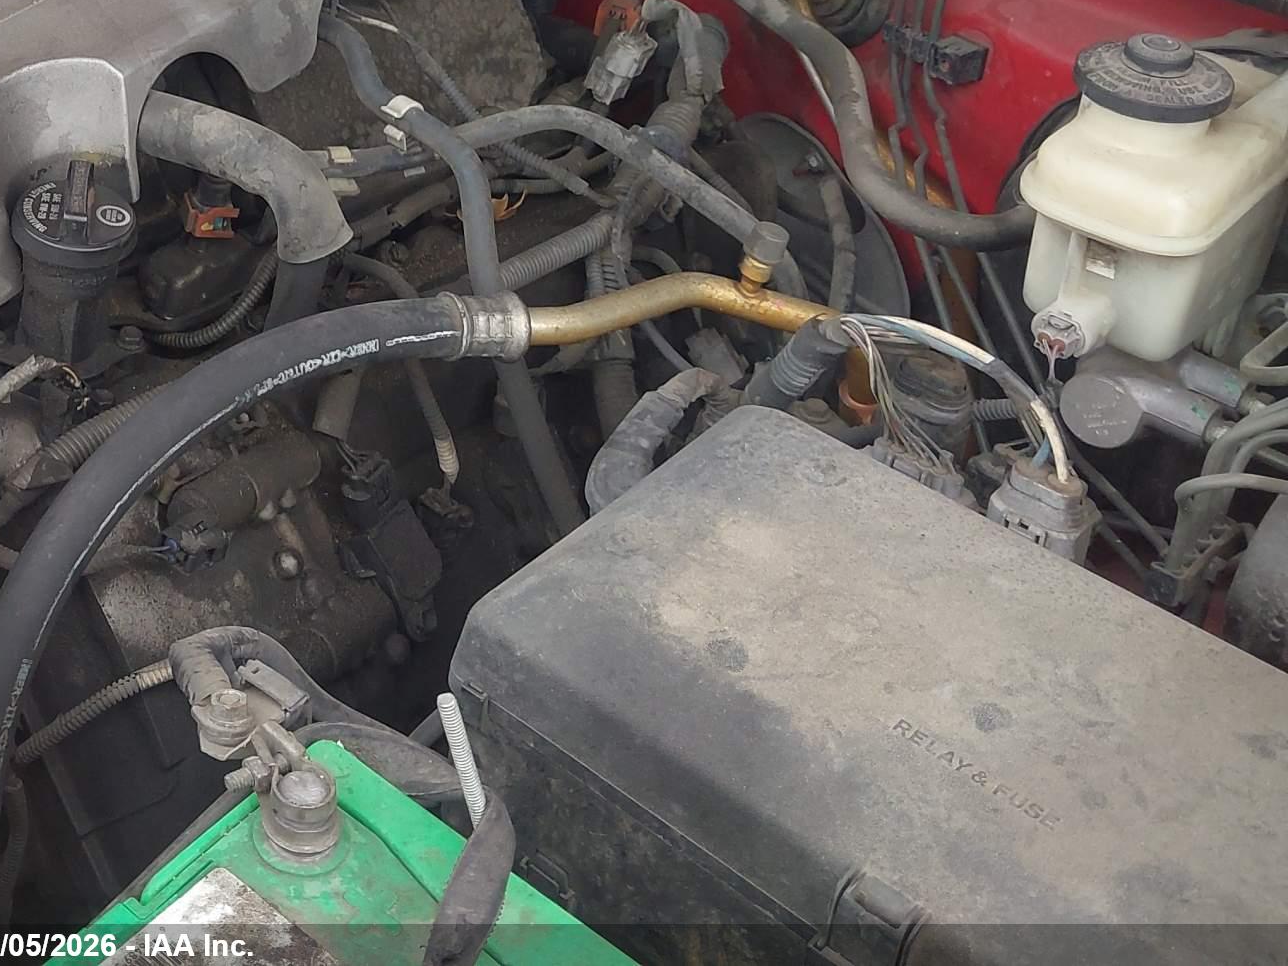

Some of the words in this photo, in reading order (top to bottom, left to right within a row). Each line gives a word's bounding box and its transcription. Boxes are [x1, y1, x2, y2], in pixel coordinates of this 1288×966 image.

[892, 719, 974, 771] RELAY
[971, 770, 988, 787] &
[992, 784, 1061, 832] FUSE
